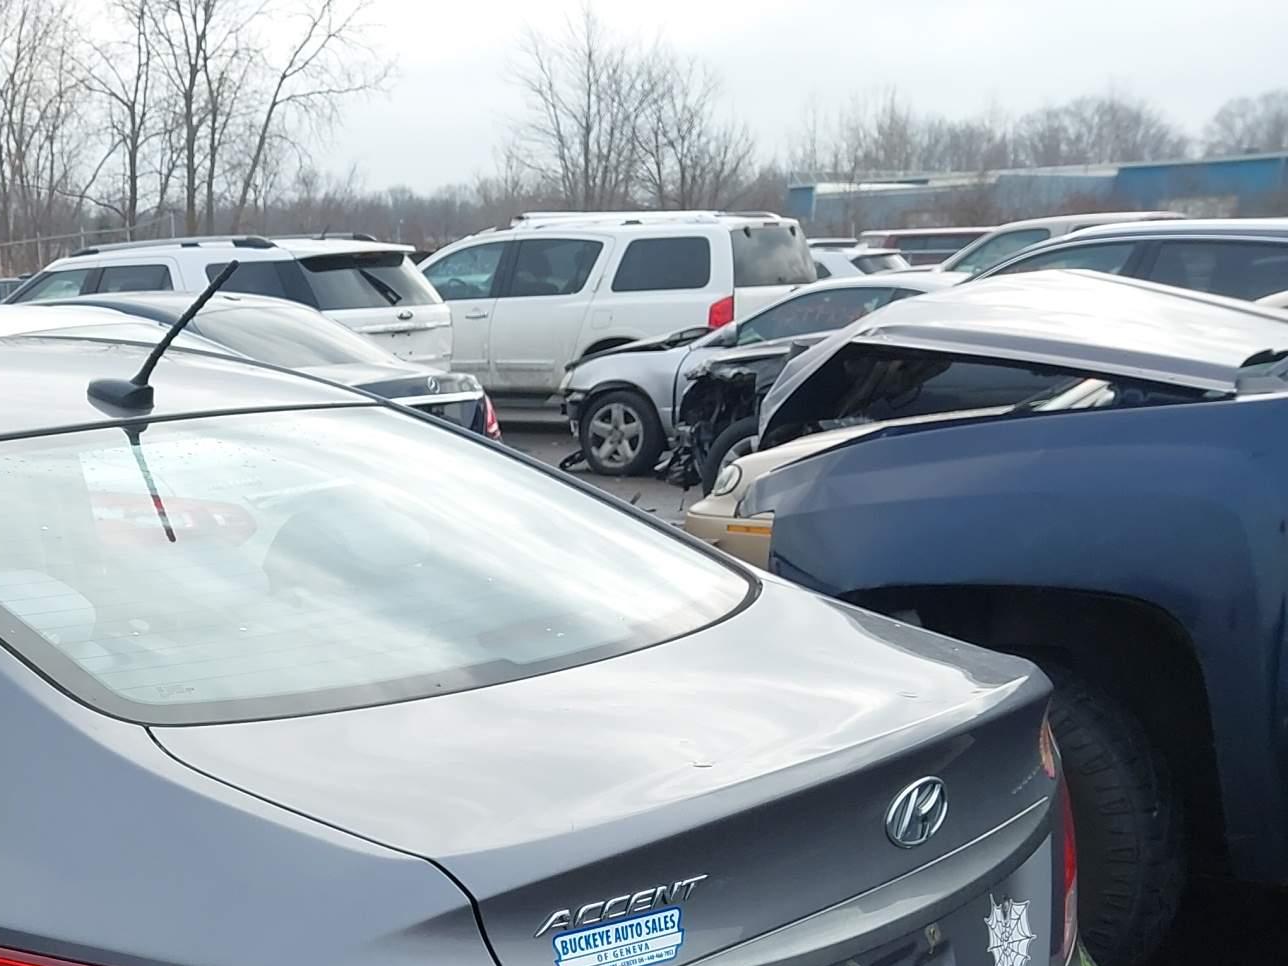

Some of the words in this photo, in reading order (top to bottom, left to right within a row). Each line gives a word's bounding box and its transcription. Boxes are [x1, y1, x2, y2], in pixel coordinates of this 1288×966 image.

[534, 874, 711, 938] ACCENT
[560, 927, 612, 956] BUCKEYE
[614, 921, 642, 945] AUTO
[645, 914, 676, 936] SALES
[597, 952, 609, 962] OF
[612, 942, 650, 959] GENEVA
